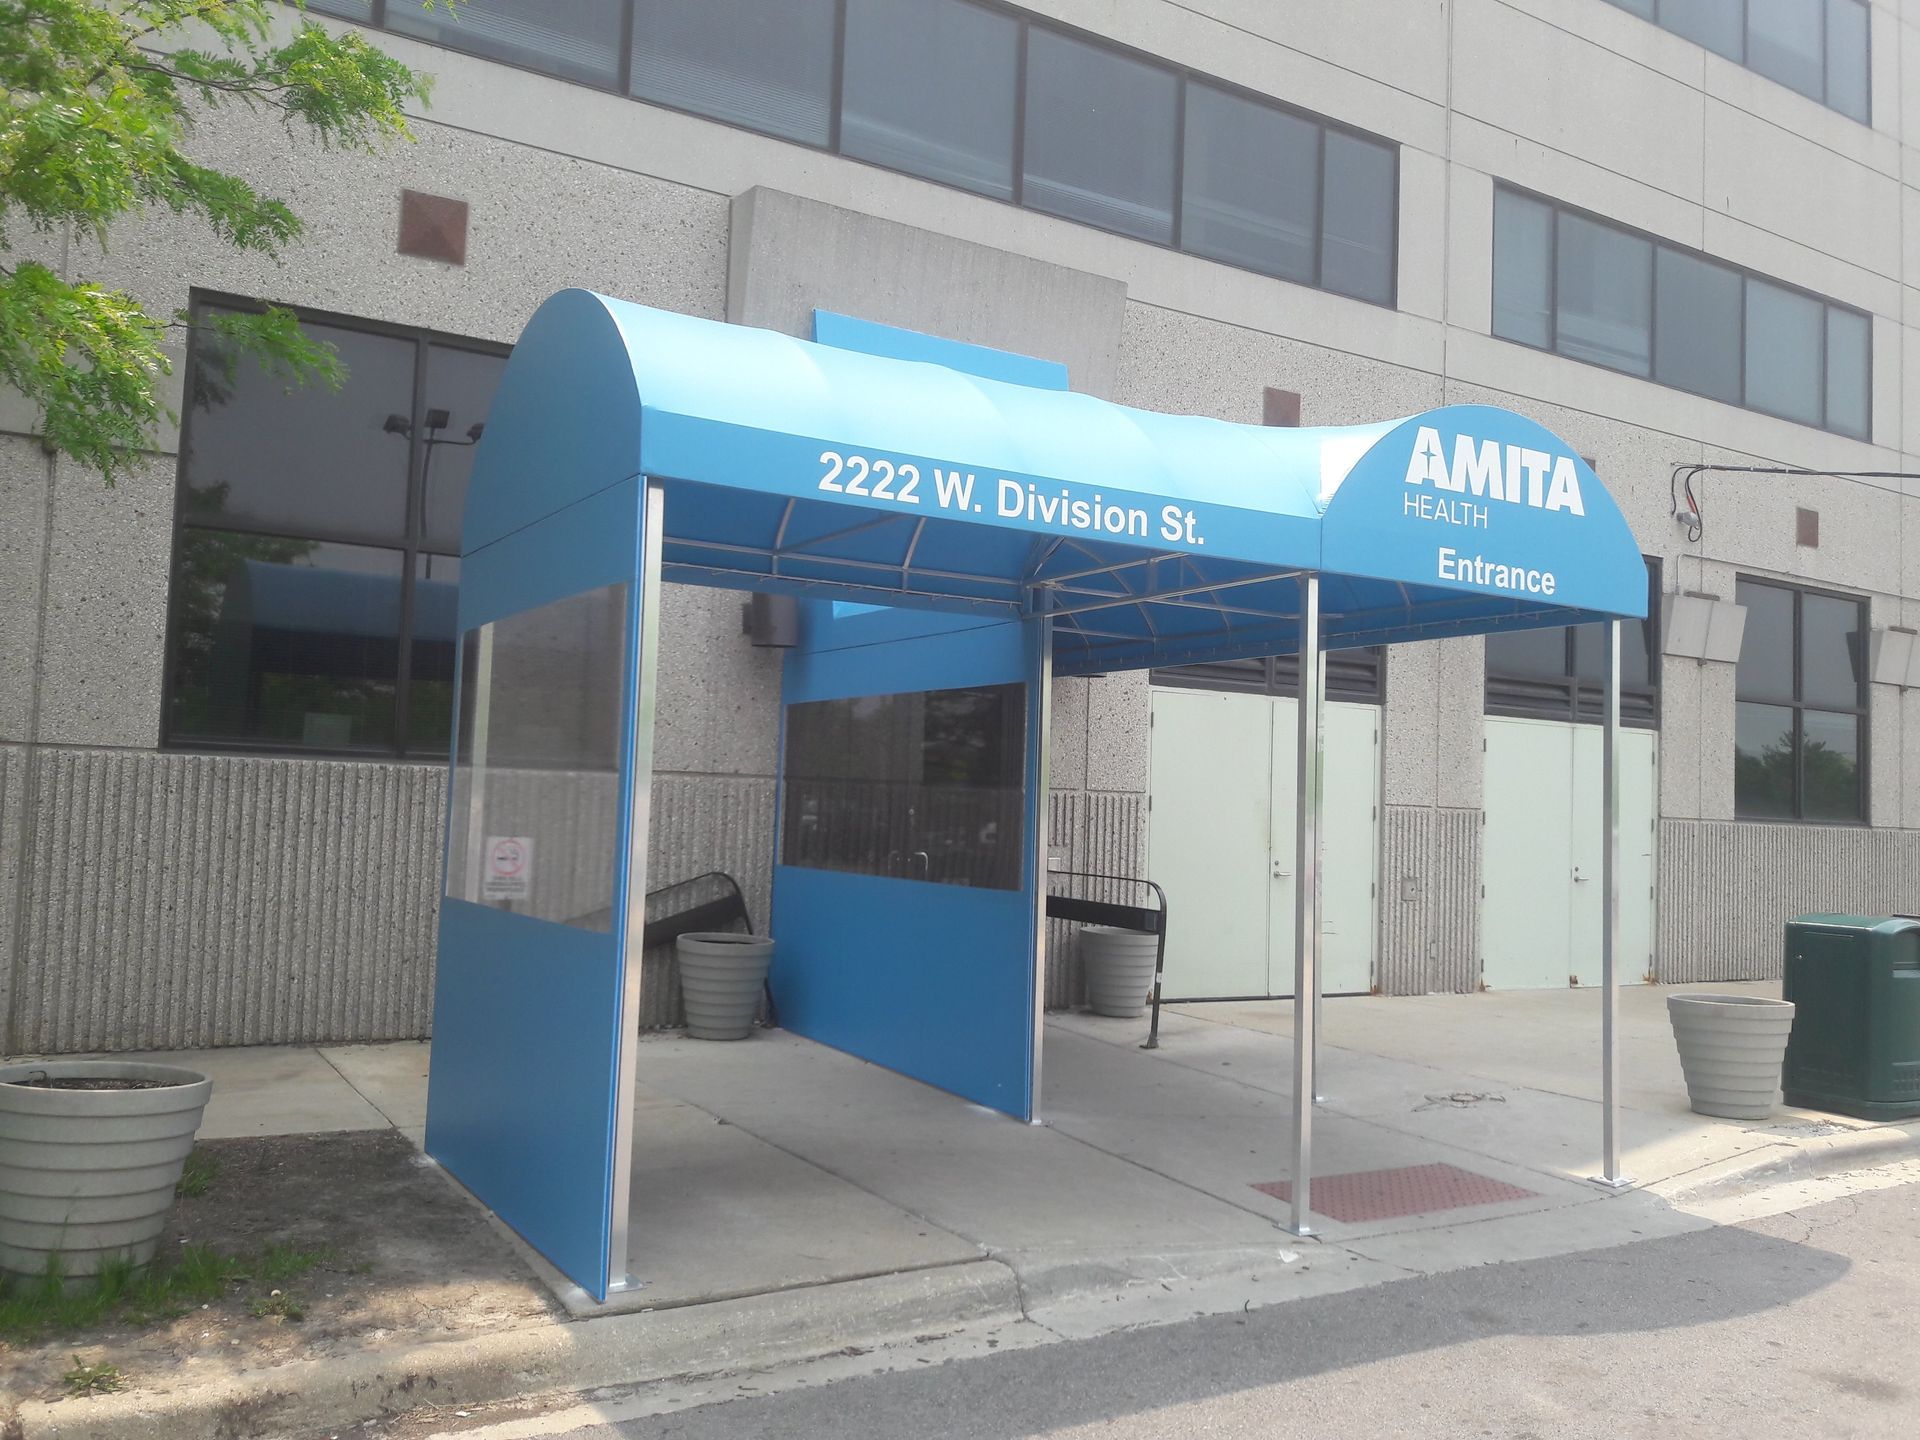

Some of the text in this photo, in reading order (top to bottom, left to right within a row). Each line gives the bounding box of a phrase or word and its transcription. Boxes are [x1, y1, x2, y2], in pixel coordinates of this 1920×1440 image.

[818, 451, 1206, 545] 2222 W. Division St.
[1405, 426, 1585, 517] AMITA
[1403, 491, 1488, 529] HEALTH
[1438, 547, 1556, 596] Entrance
